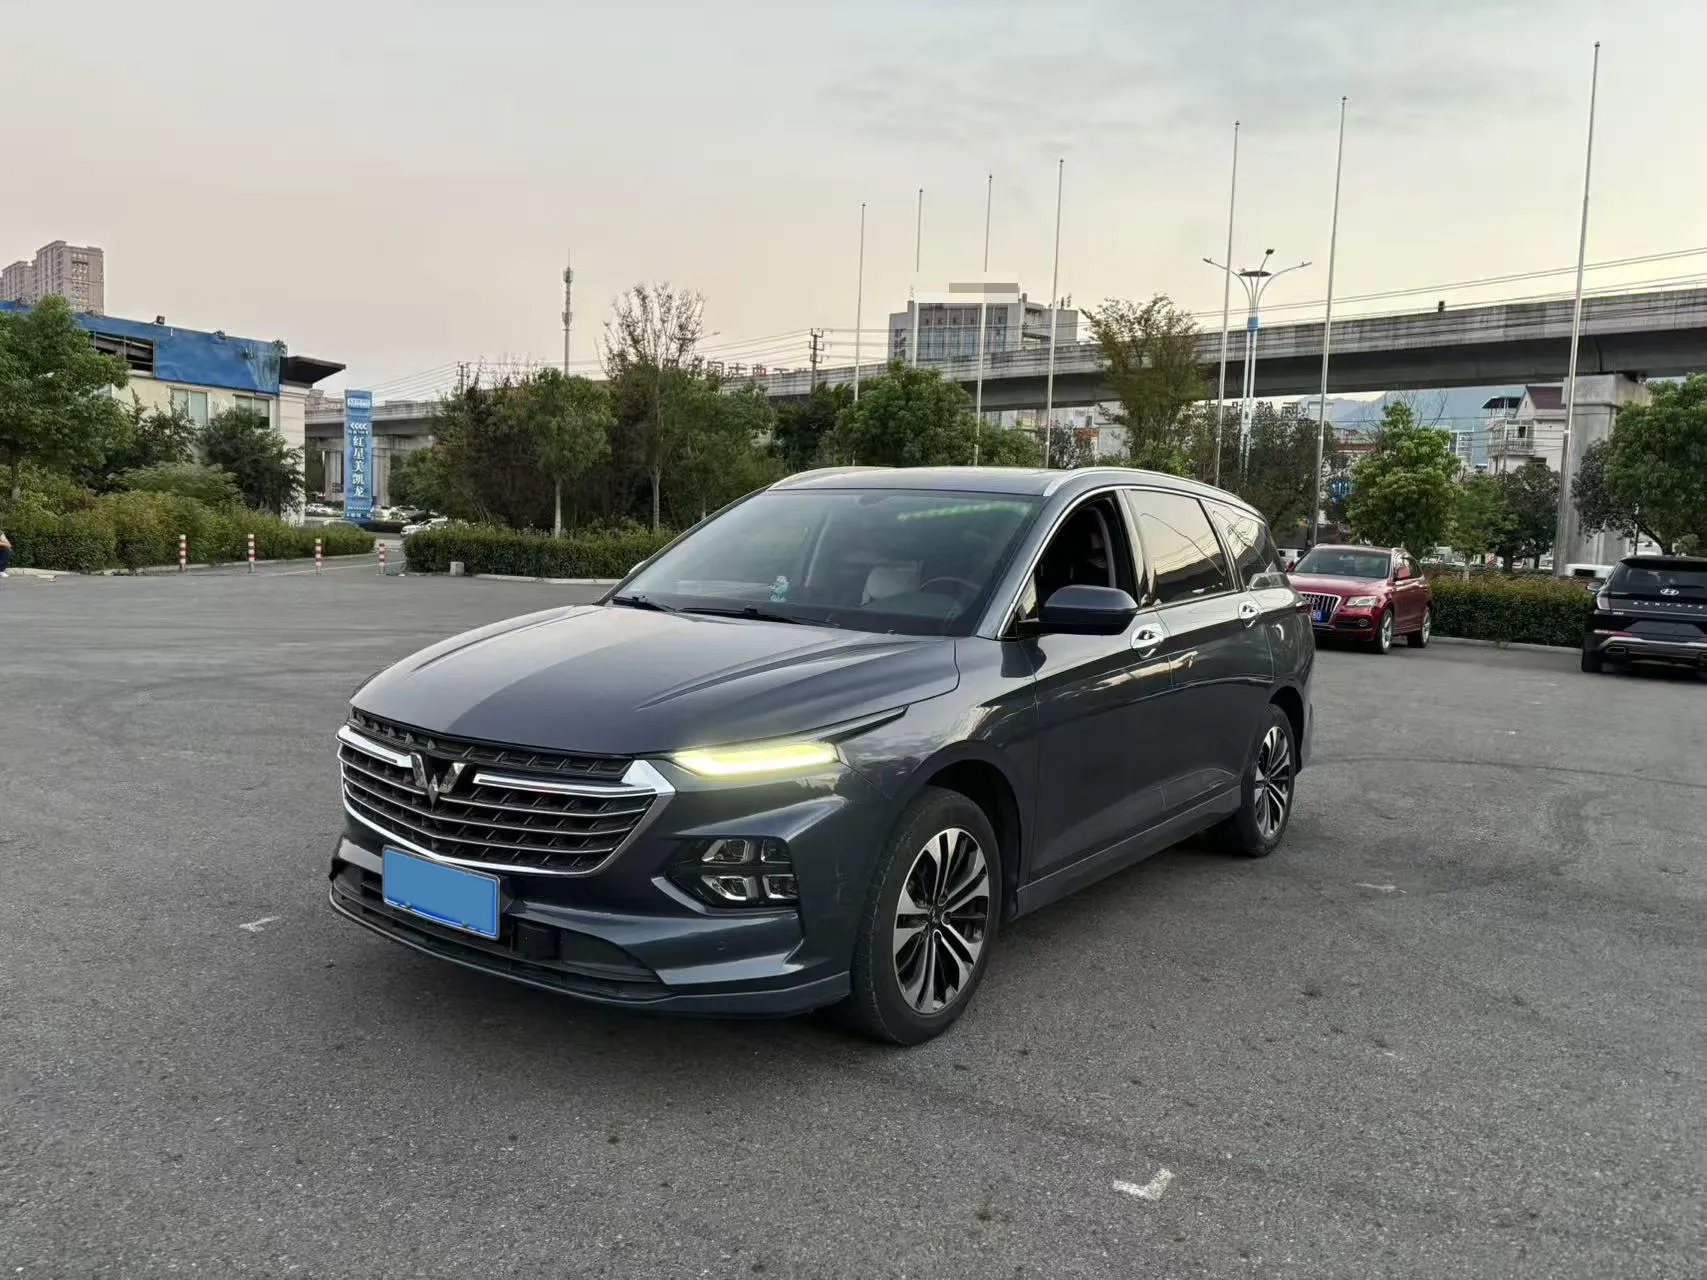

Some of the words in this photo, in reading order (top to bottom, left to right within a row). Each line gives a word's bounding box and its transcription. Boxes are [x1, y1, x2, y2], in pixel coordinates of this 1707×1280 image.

[352, 436, 365, 497] 红星美凯龙
